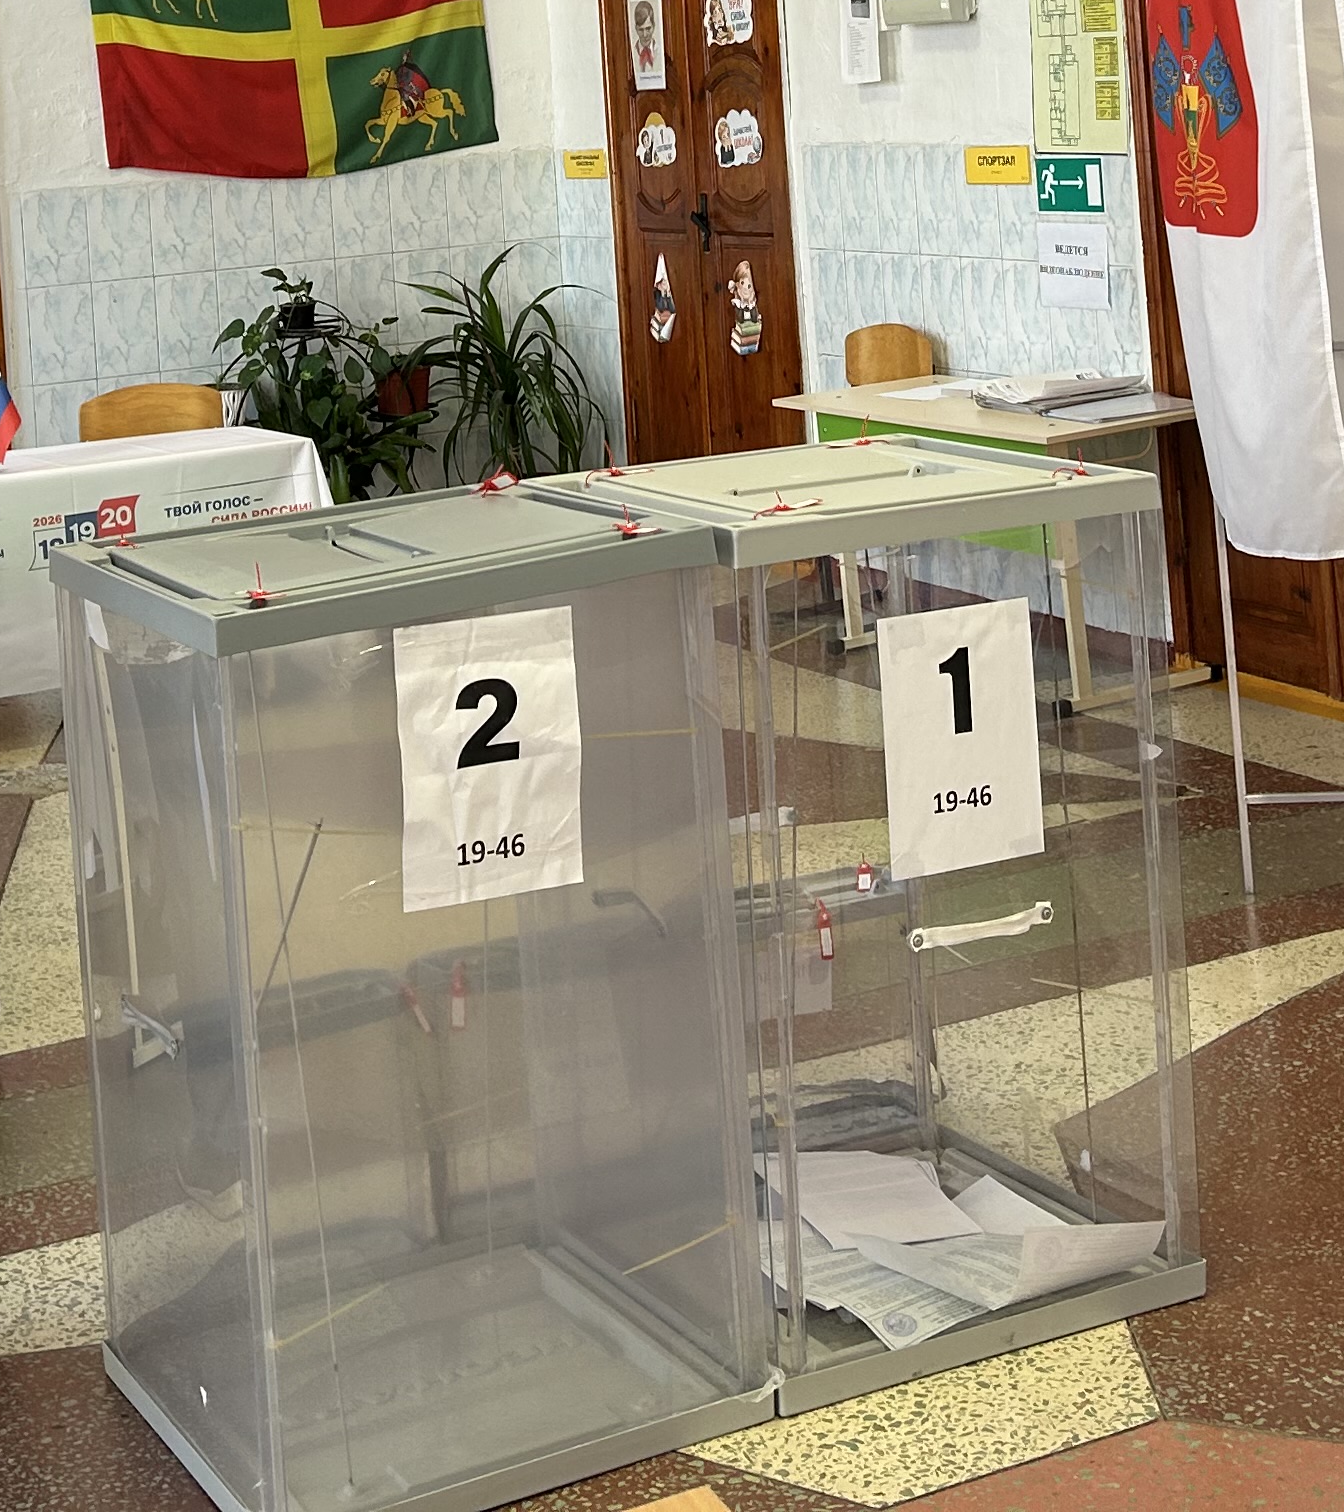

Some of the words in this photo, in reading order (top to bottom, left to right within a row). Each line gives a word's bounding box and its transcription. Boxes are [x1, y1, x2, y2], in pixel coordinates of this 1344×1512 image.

[100, 505, 133, 530] 20
[164, 500, 202, 518] ТВОЙ
[205, 495, 252, 513] ГОЛОС
[32, 514, 63, 528] 2026
[68, 520, 97, 544] 19
[938, 646, 974, 735] 1
[455, 678, 520, 770] 2
[932, 784, 993, 815] 19-46
[456, 833, 526, 867] 19-46
